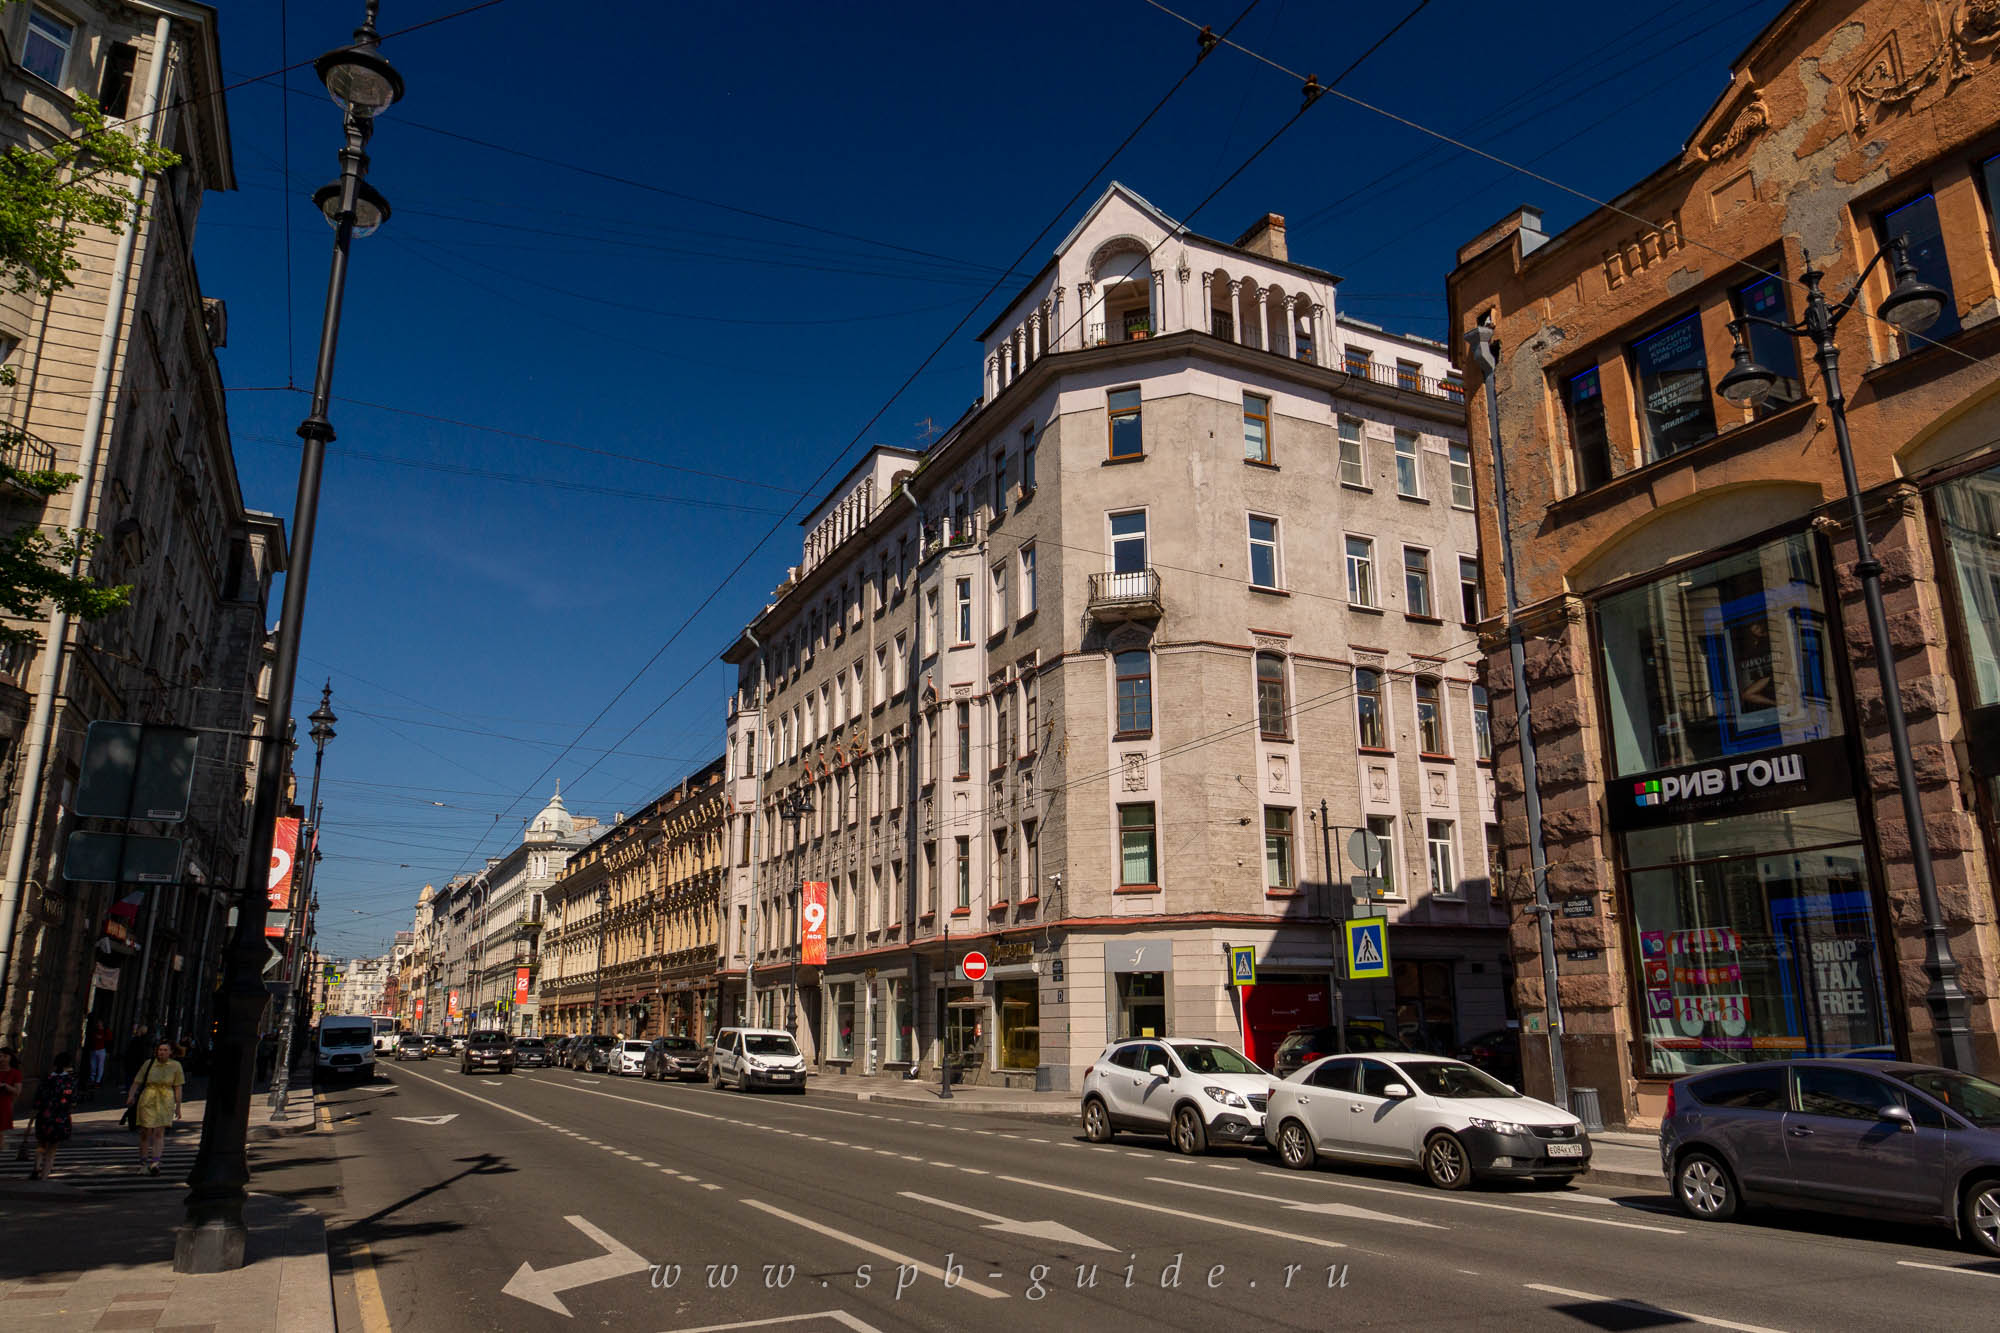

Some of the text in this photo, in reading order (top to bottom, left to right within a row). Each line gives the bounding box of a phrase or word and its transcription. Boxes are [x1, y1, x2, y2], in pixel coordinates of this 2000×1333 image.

[1661, 753, 1807, 803] РИВ ГОШ
[805, 903, 825, 932] 9
[1810, 939, 1857, 962] SHOP
[1813, 961, 1862, 990] TAX
[1817, 990, 1866, 1015] FREE
